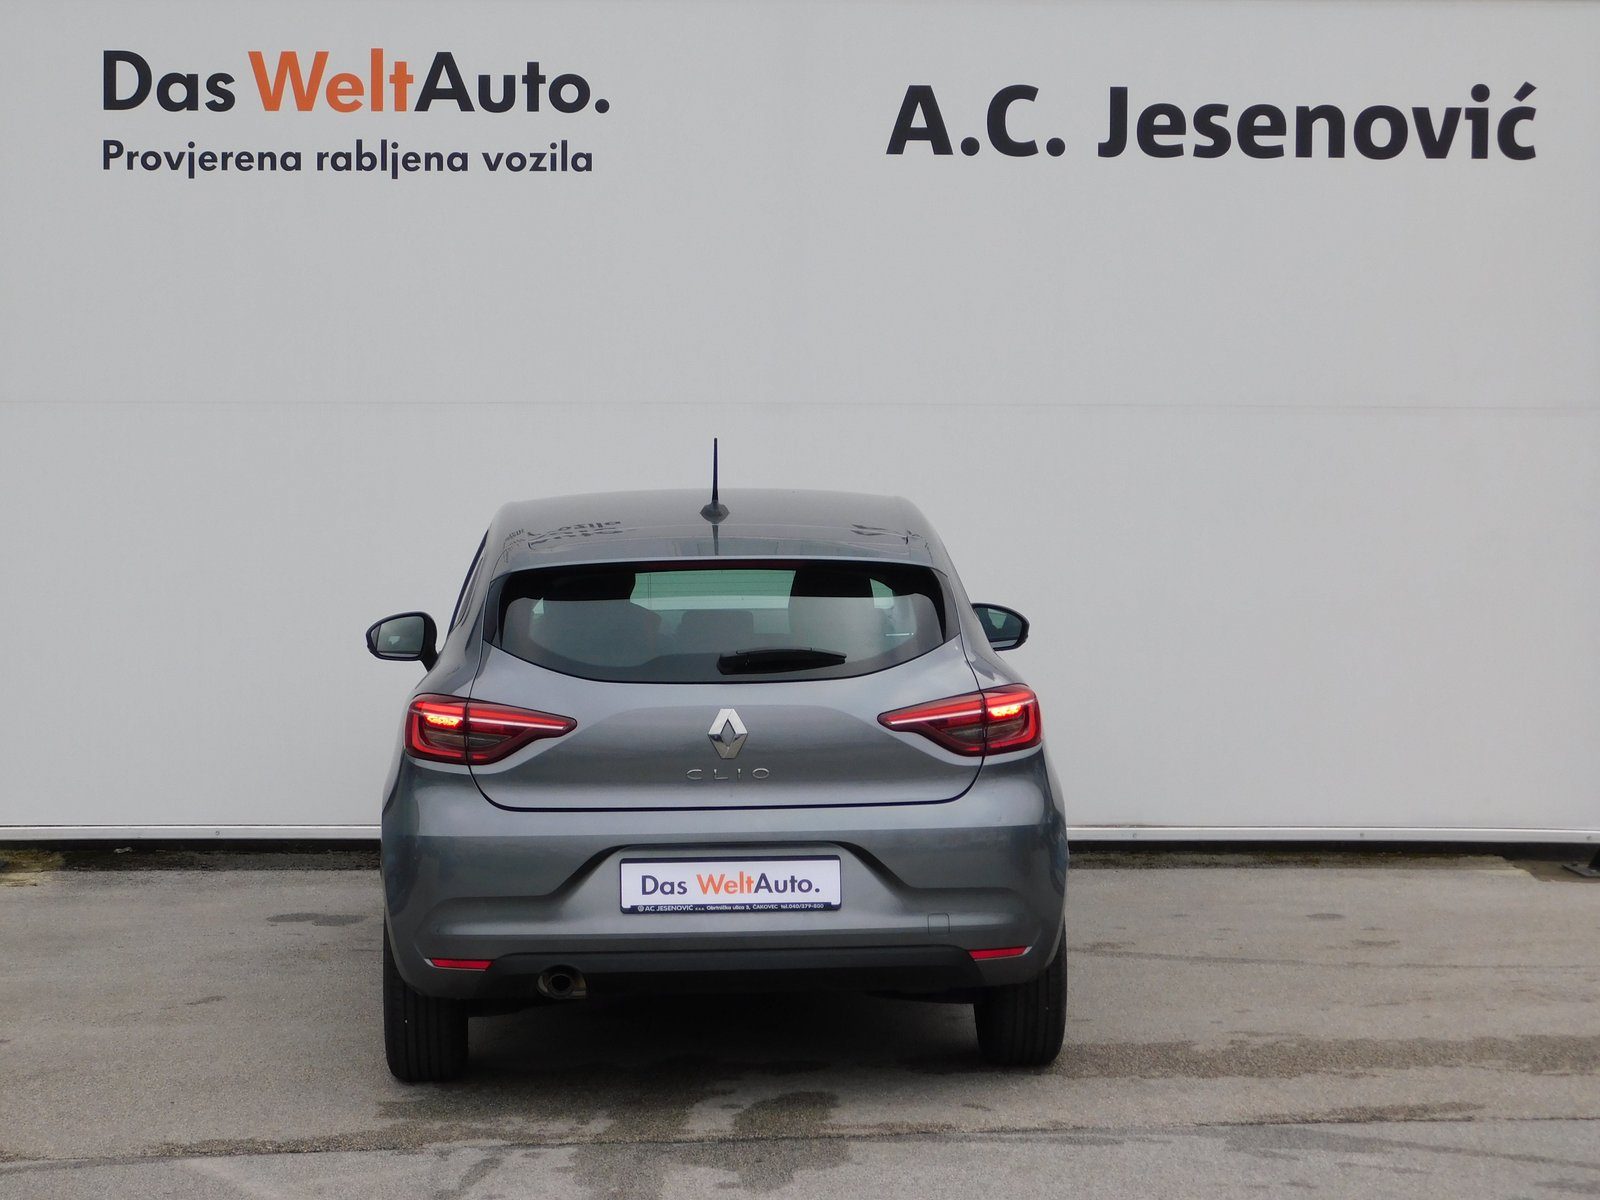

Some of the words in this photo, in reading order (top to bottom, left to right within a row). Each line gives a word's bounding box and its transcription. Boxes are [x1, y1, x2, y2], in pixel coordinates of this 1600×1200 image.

[103, 50, 235, 113] Das
[248, 48, 609, 113] WeltAuto.
[886, 84, 1065, 157] A.C.
[1098, 81, 1537, 160] Jesenović
[103, 140, 301, 179] Provjerena
[317, 139, 468, 179] rabljena
[482, 140, 592, 172] vozila
[686, 767, 770, 780] CLIO
[641, 874, 688, 896] Das
[696, 871, 821, 895] WeltAuto.
